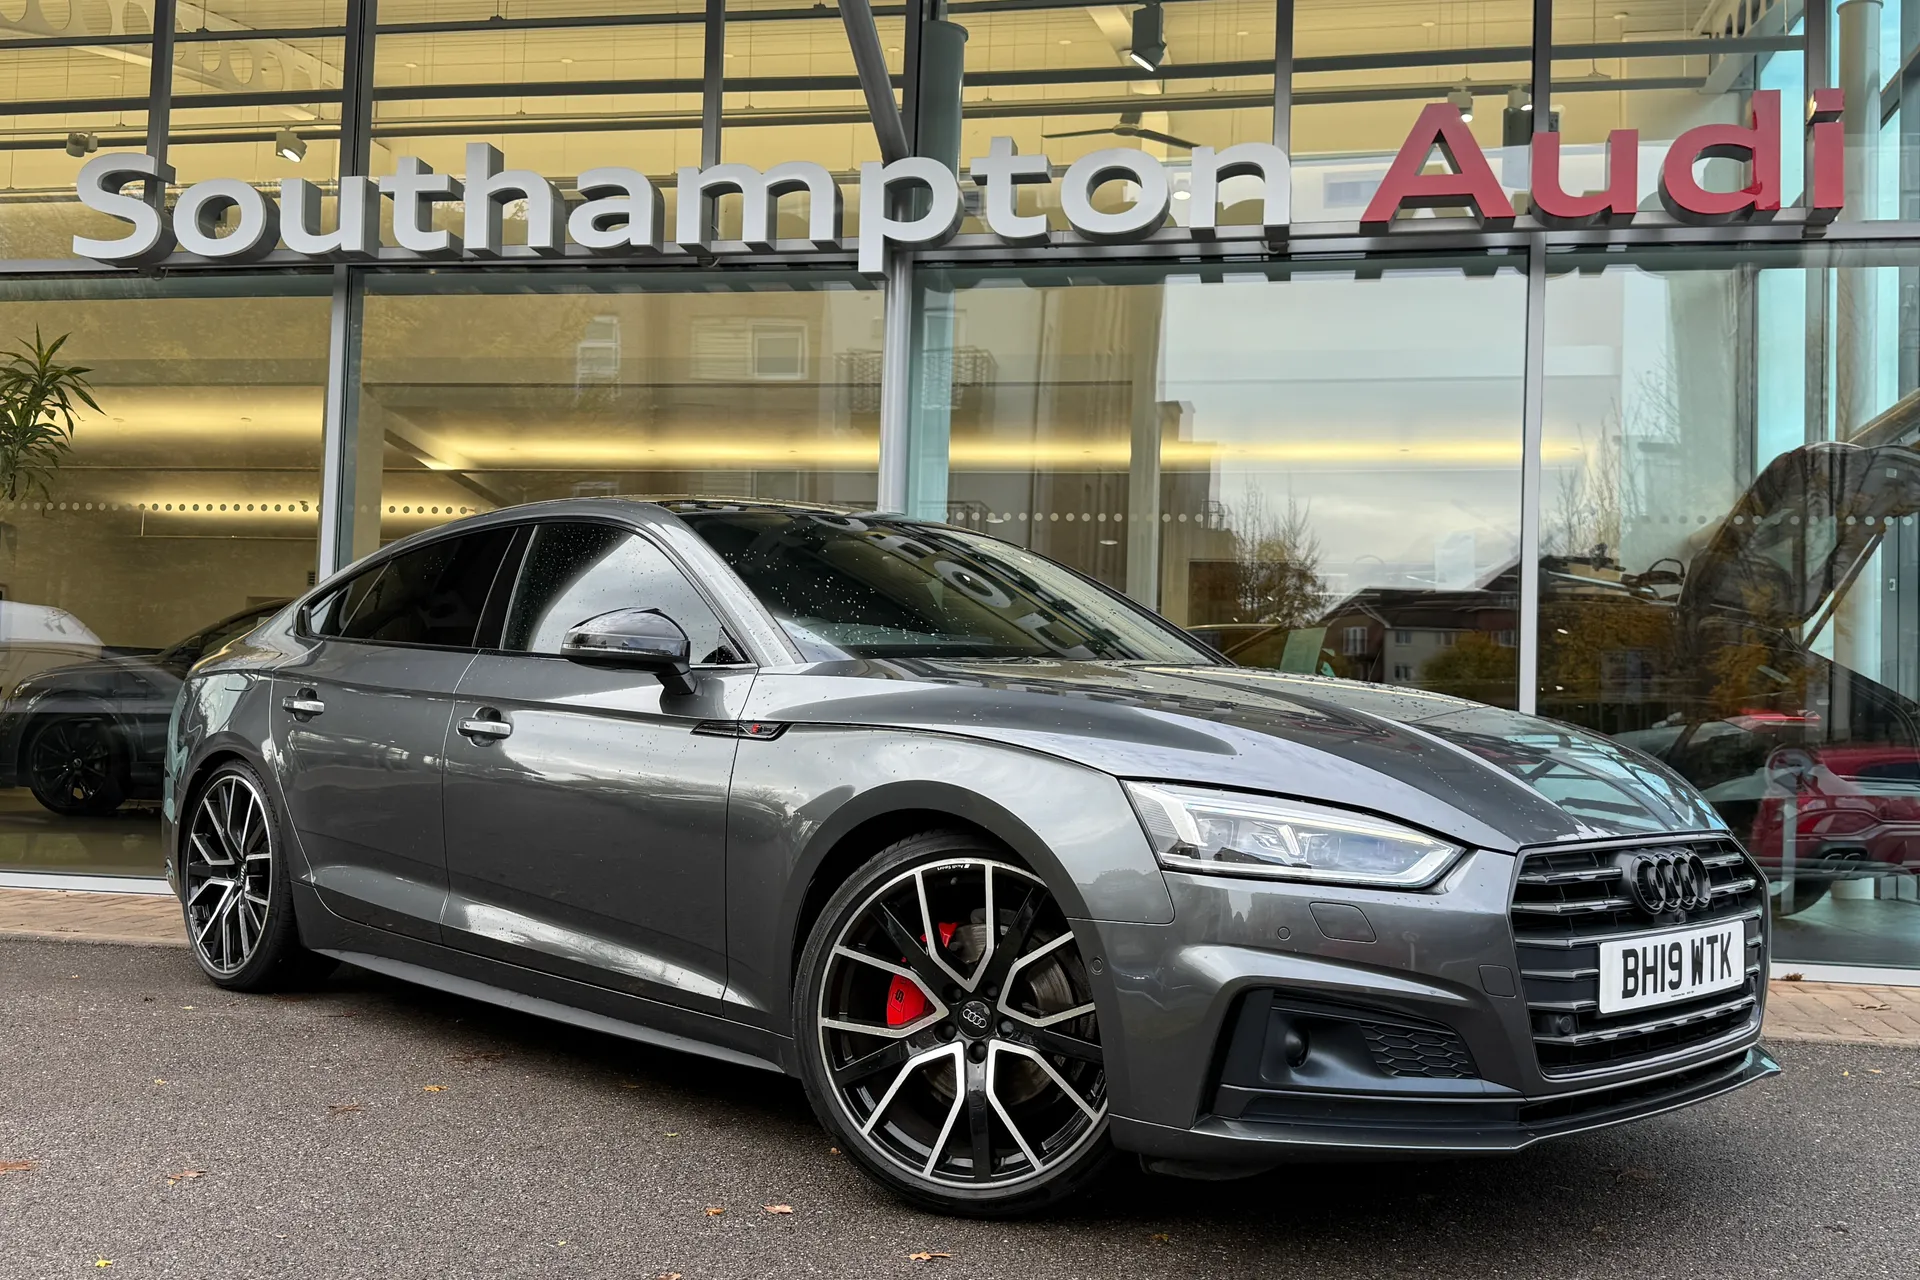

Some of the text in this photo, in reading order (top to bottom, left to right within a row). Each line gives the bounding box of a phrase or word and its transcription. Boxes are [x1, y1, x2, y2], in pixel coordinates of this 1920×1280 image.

[72, 88, 1845, 274] Southampton Audi
[1621, 931, 1732, 1000] BH19 WTK
